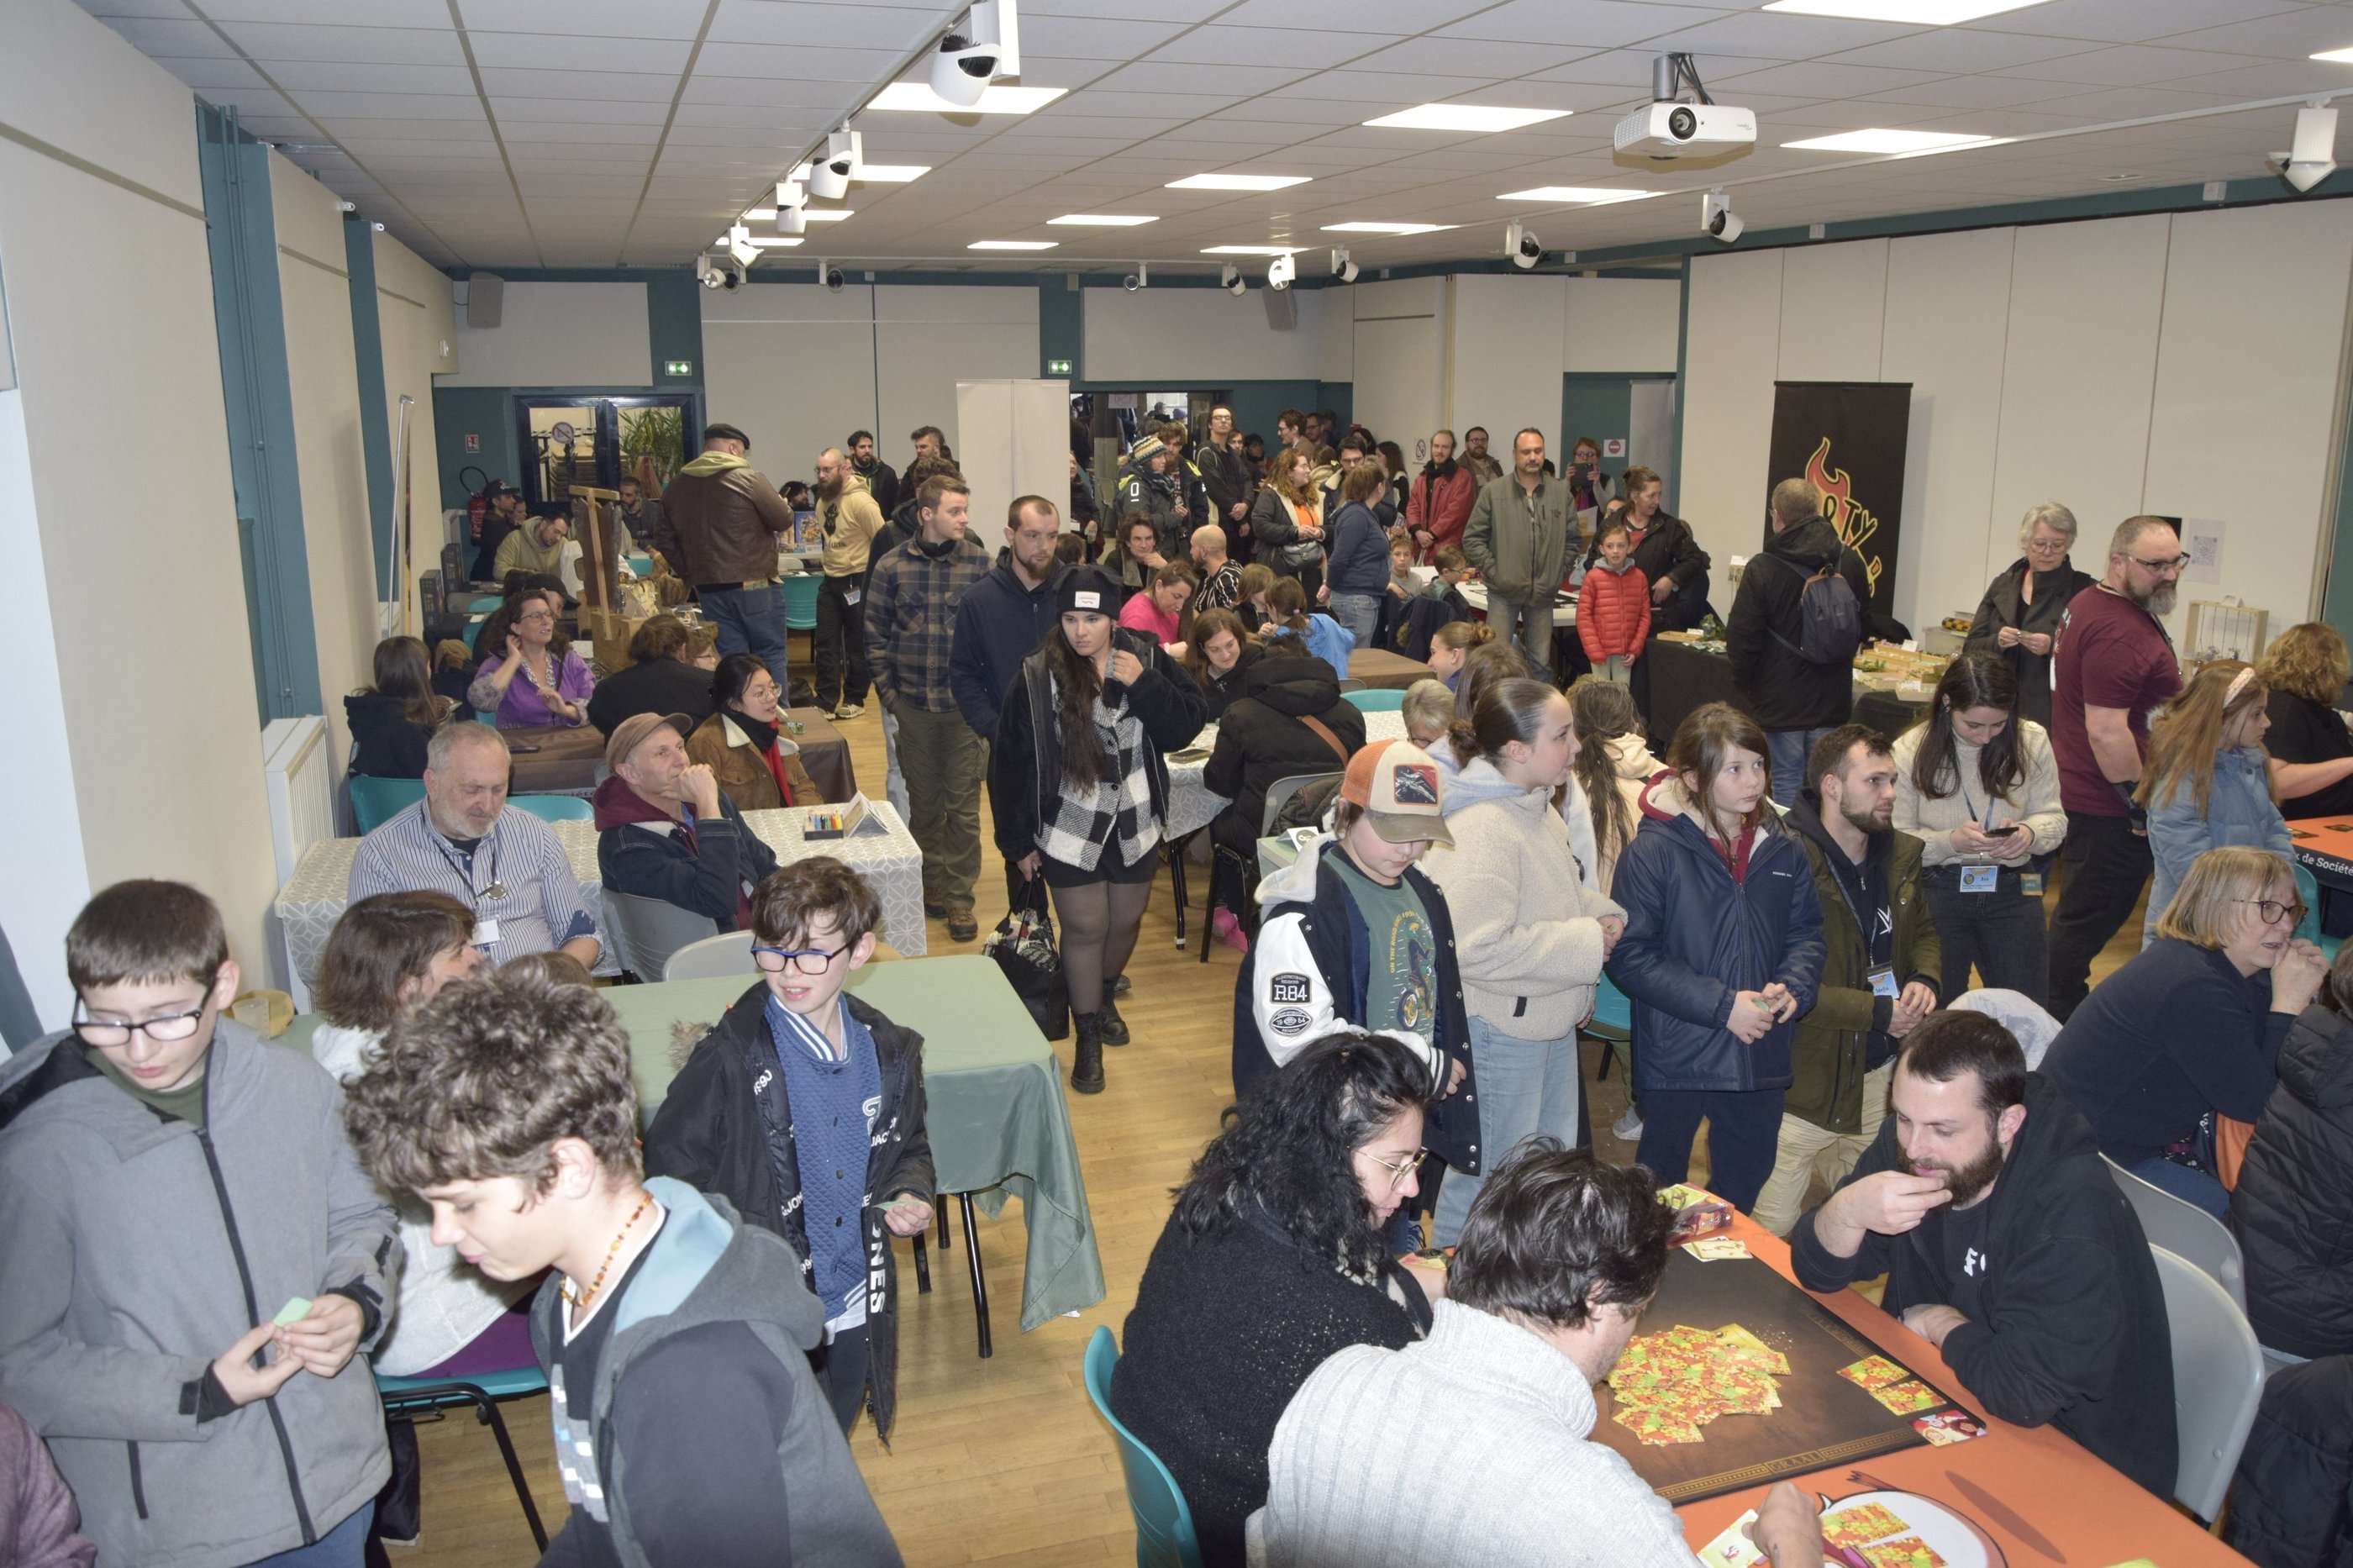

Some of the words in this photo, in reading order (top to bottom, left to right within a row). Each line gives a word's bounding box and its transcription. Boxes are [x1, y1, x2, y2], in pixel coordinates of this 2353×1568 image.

[2302, 853, 2315, 865] de
[1273, 984, 1308, 1002] R84
[1771, 1453, 1822, 1471] GRAAL
